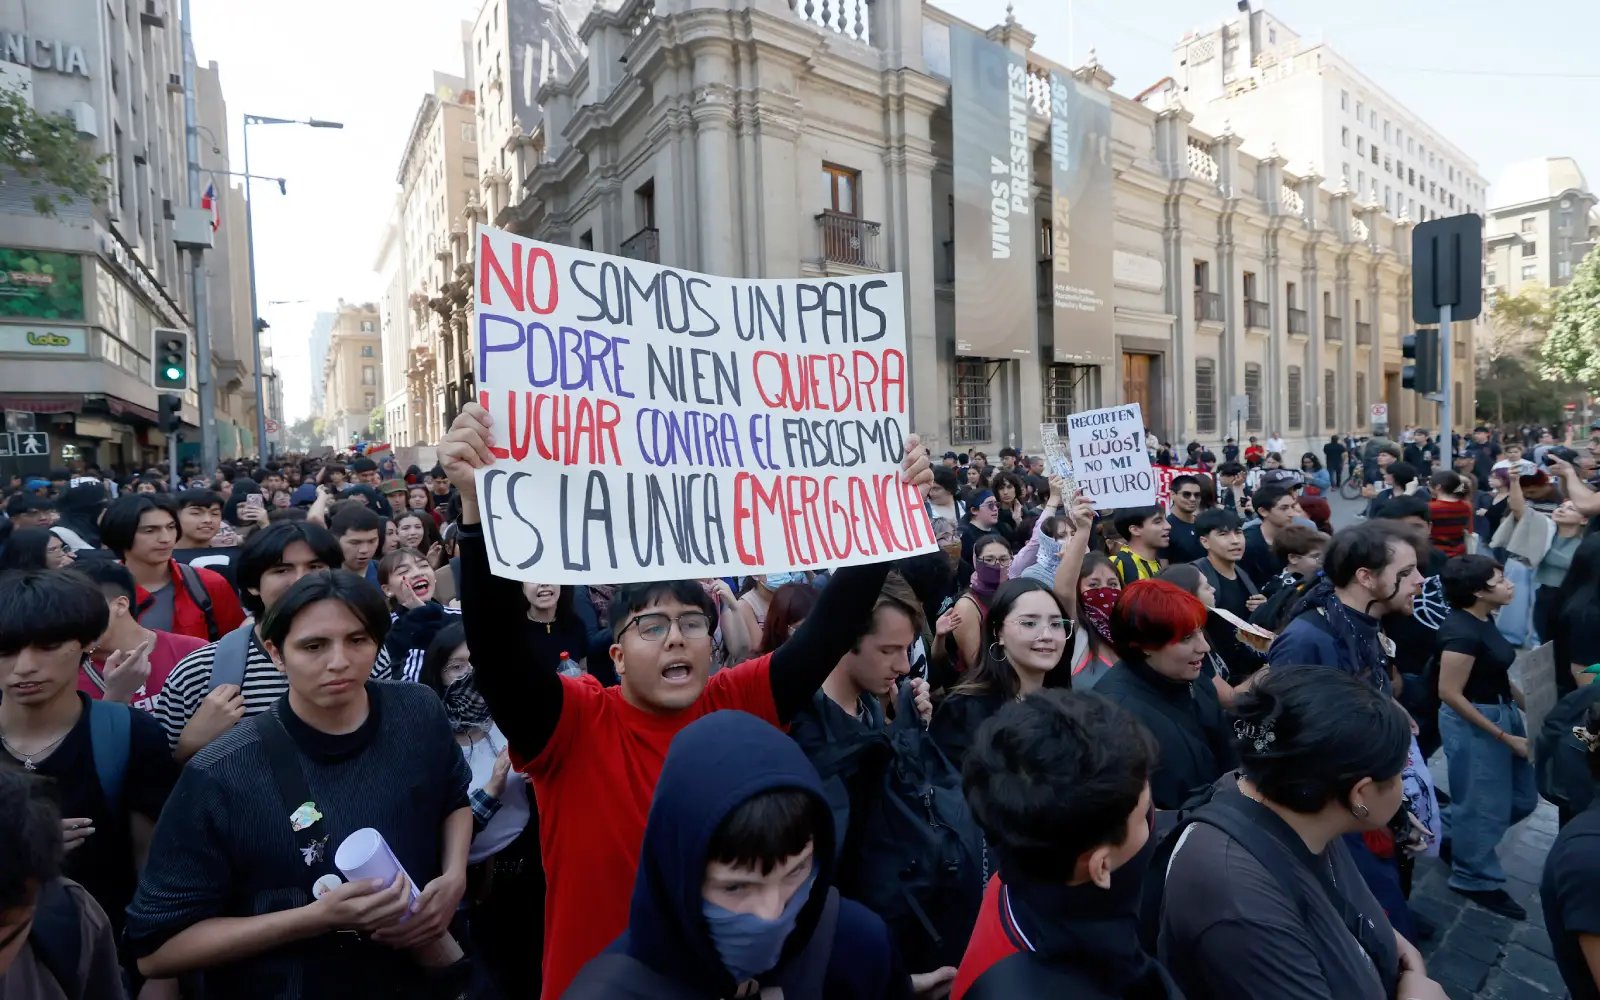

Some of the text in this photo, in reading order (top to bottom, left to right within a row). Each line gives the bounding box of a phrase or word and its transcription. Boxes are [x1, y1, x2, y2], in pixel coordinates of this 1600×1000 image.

[1007, 62, 1029, 215] PRESENTES
[1051, 122, 1069, 172] JUN
[991, 155, 1010, 260] VIVOS Y
[1055, 230, 1070, 273] DIC
[480, 233, 888, 344] NO SOMOS UN PAIS
[27, 331, 71, 346] Loto
[479, 313, 636, 399] POBRE
[691, 348, 742, 407] EN
[752, 348, 905, 414] QUIEBRA
[636, 407, 745, 468] CONTRA
[749, 413, 781, 471] EL
[782, 417, 905, 468] FASCISMO
[1070, 408, 1135, 430] RECORTEN
[1091, 426, 1119, 441] SUS
[1078, 431, 1141, 458] LUJOS!
[1084, 455, 1132, 473] NO MI
[1078, 471, 1151, 497] FUTURO
[483, 469, 937, 572] ES LA UNICA EMERGENCIA
